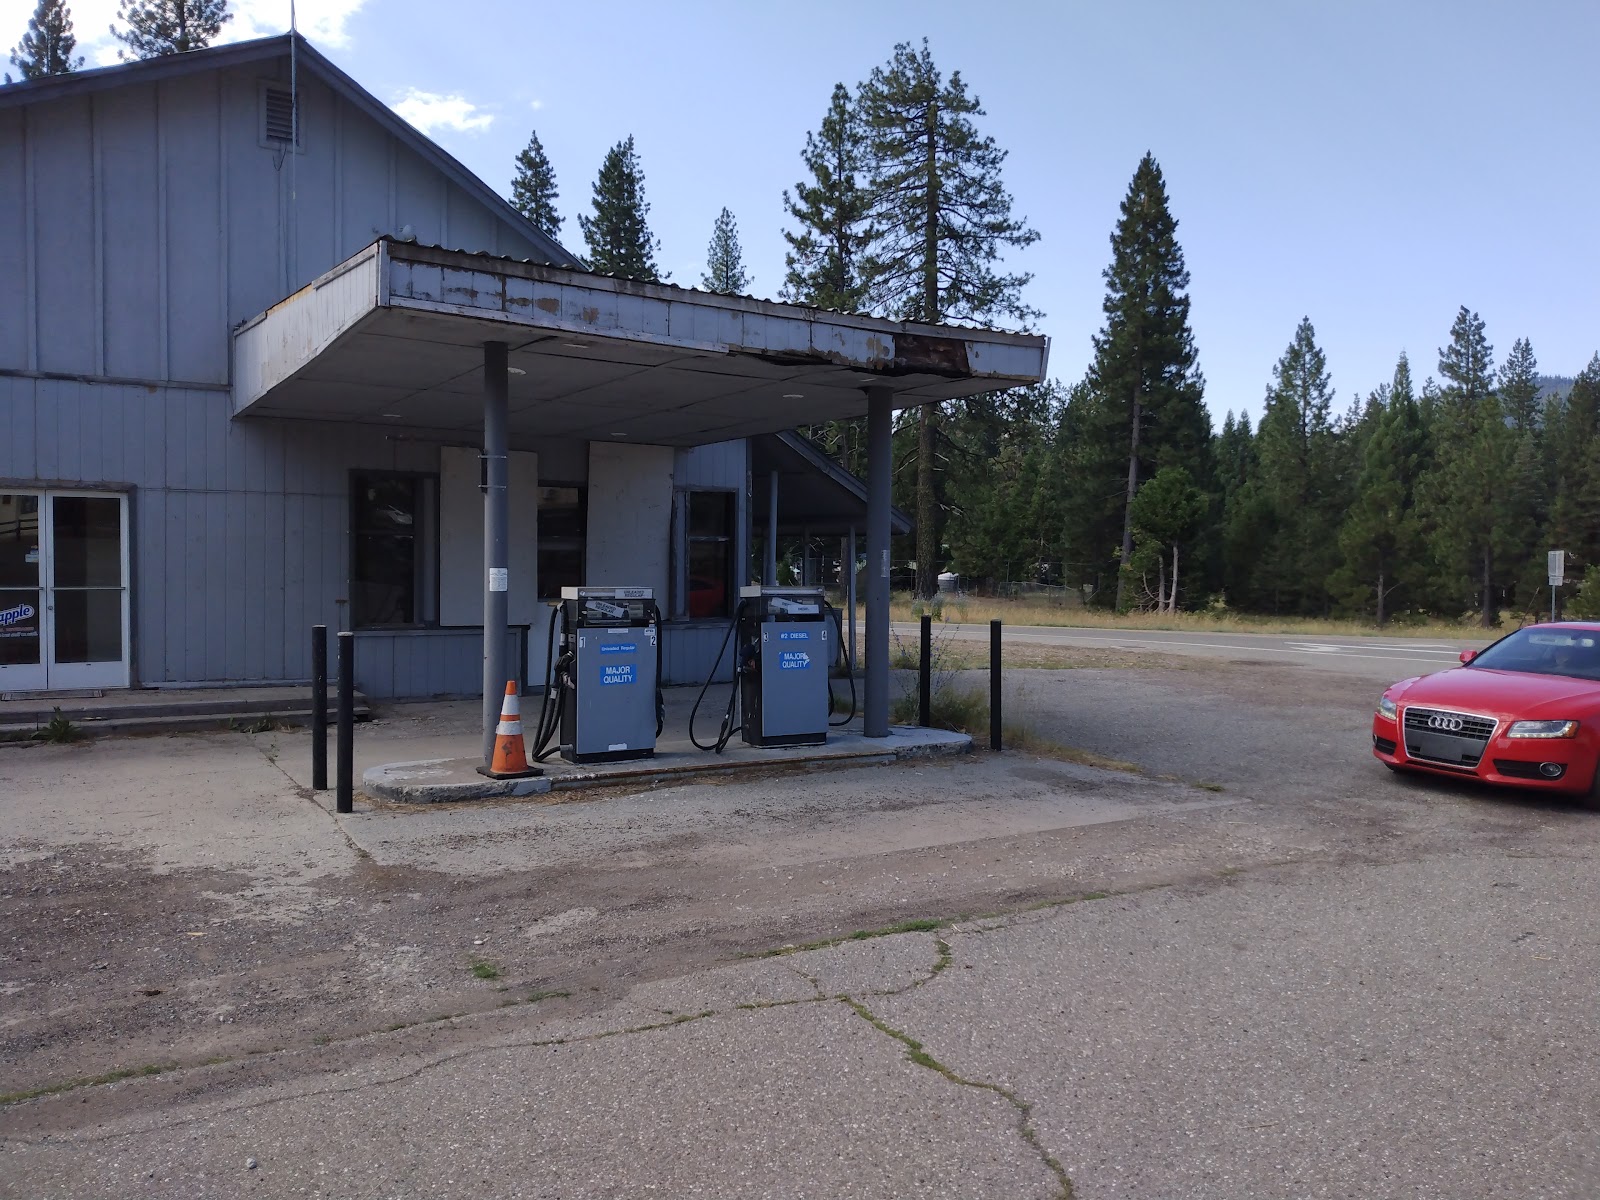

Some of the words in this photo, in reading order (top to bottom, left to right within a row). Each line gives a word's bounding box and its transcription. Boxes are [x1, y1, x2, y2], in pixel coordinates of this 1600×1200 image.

[651, 636, 656, 646] 2
[606, 666, 630, 674] MAJOR
[604, 675, 633, 684] QUALITY
